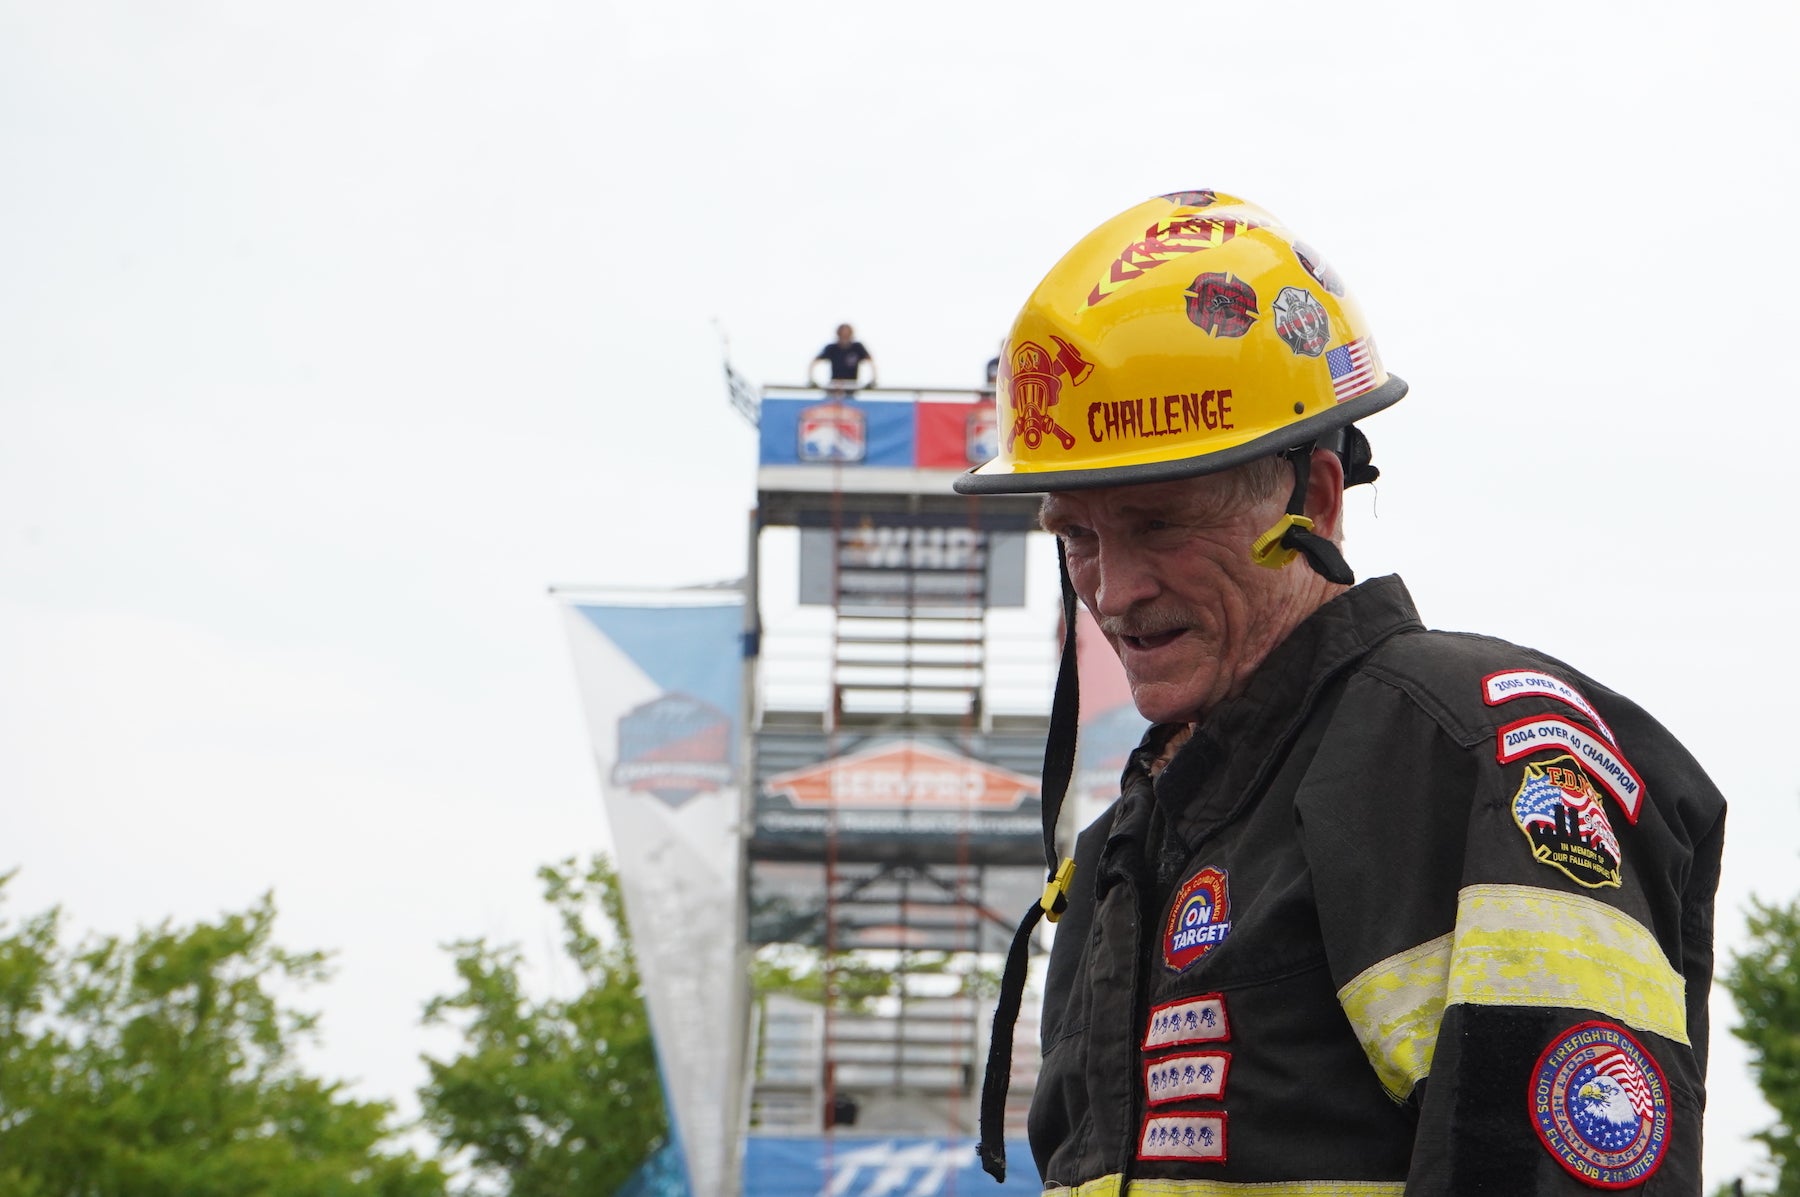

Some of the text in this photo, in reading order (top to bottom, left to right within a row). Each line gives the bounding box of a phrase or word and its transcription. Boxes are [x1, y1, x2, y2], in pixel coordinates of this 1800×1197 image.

[1088, 389, 1234, 443] CHALLENGE
[1495, 678, 1523, 691] 2005
[1526, 678, 1556, 690] OVER
[1559, 687, 1571, 697] 40
[1506, 726, 1637, 794] 2004 OVER 40 CHAMPION
[1553, 852, 1568, 862] OUR
[1569, 855, 1592, 869] FALLEN
[1561, 843, 1569, 851] IN
[1186, 906, 1211, 927] ON
[1212, 880, 1222, 921] CHALLENGE
[1173, 924, 1228, 952] TARGET
[1549, 1030, 1620, 1068] FIREFIGHTER
[1621, 1039, 1665, 1106] CHALLENGE
[1653, 1112, 1666, 1142] 2000
[1557, 1048, 1596, 1090] SCOTT
[1553, 1095, 1589, 1155] HEALTH
[1546, 1129, 1600, 1180] ELITE-SUB
[1603, 1171, 1610, 1182] 2
[1606, 1133, 1648, 1166] SAFETY
